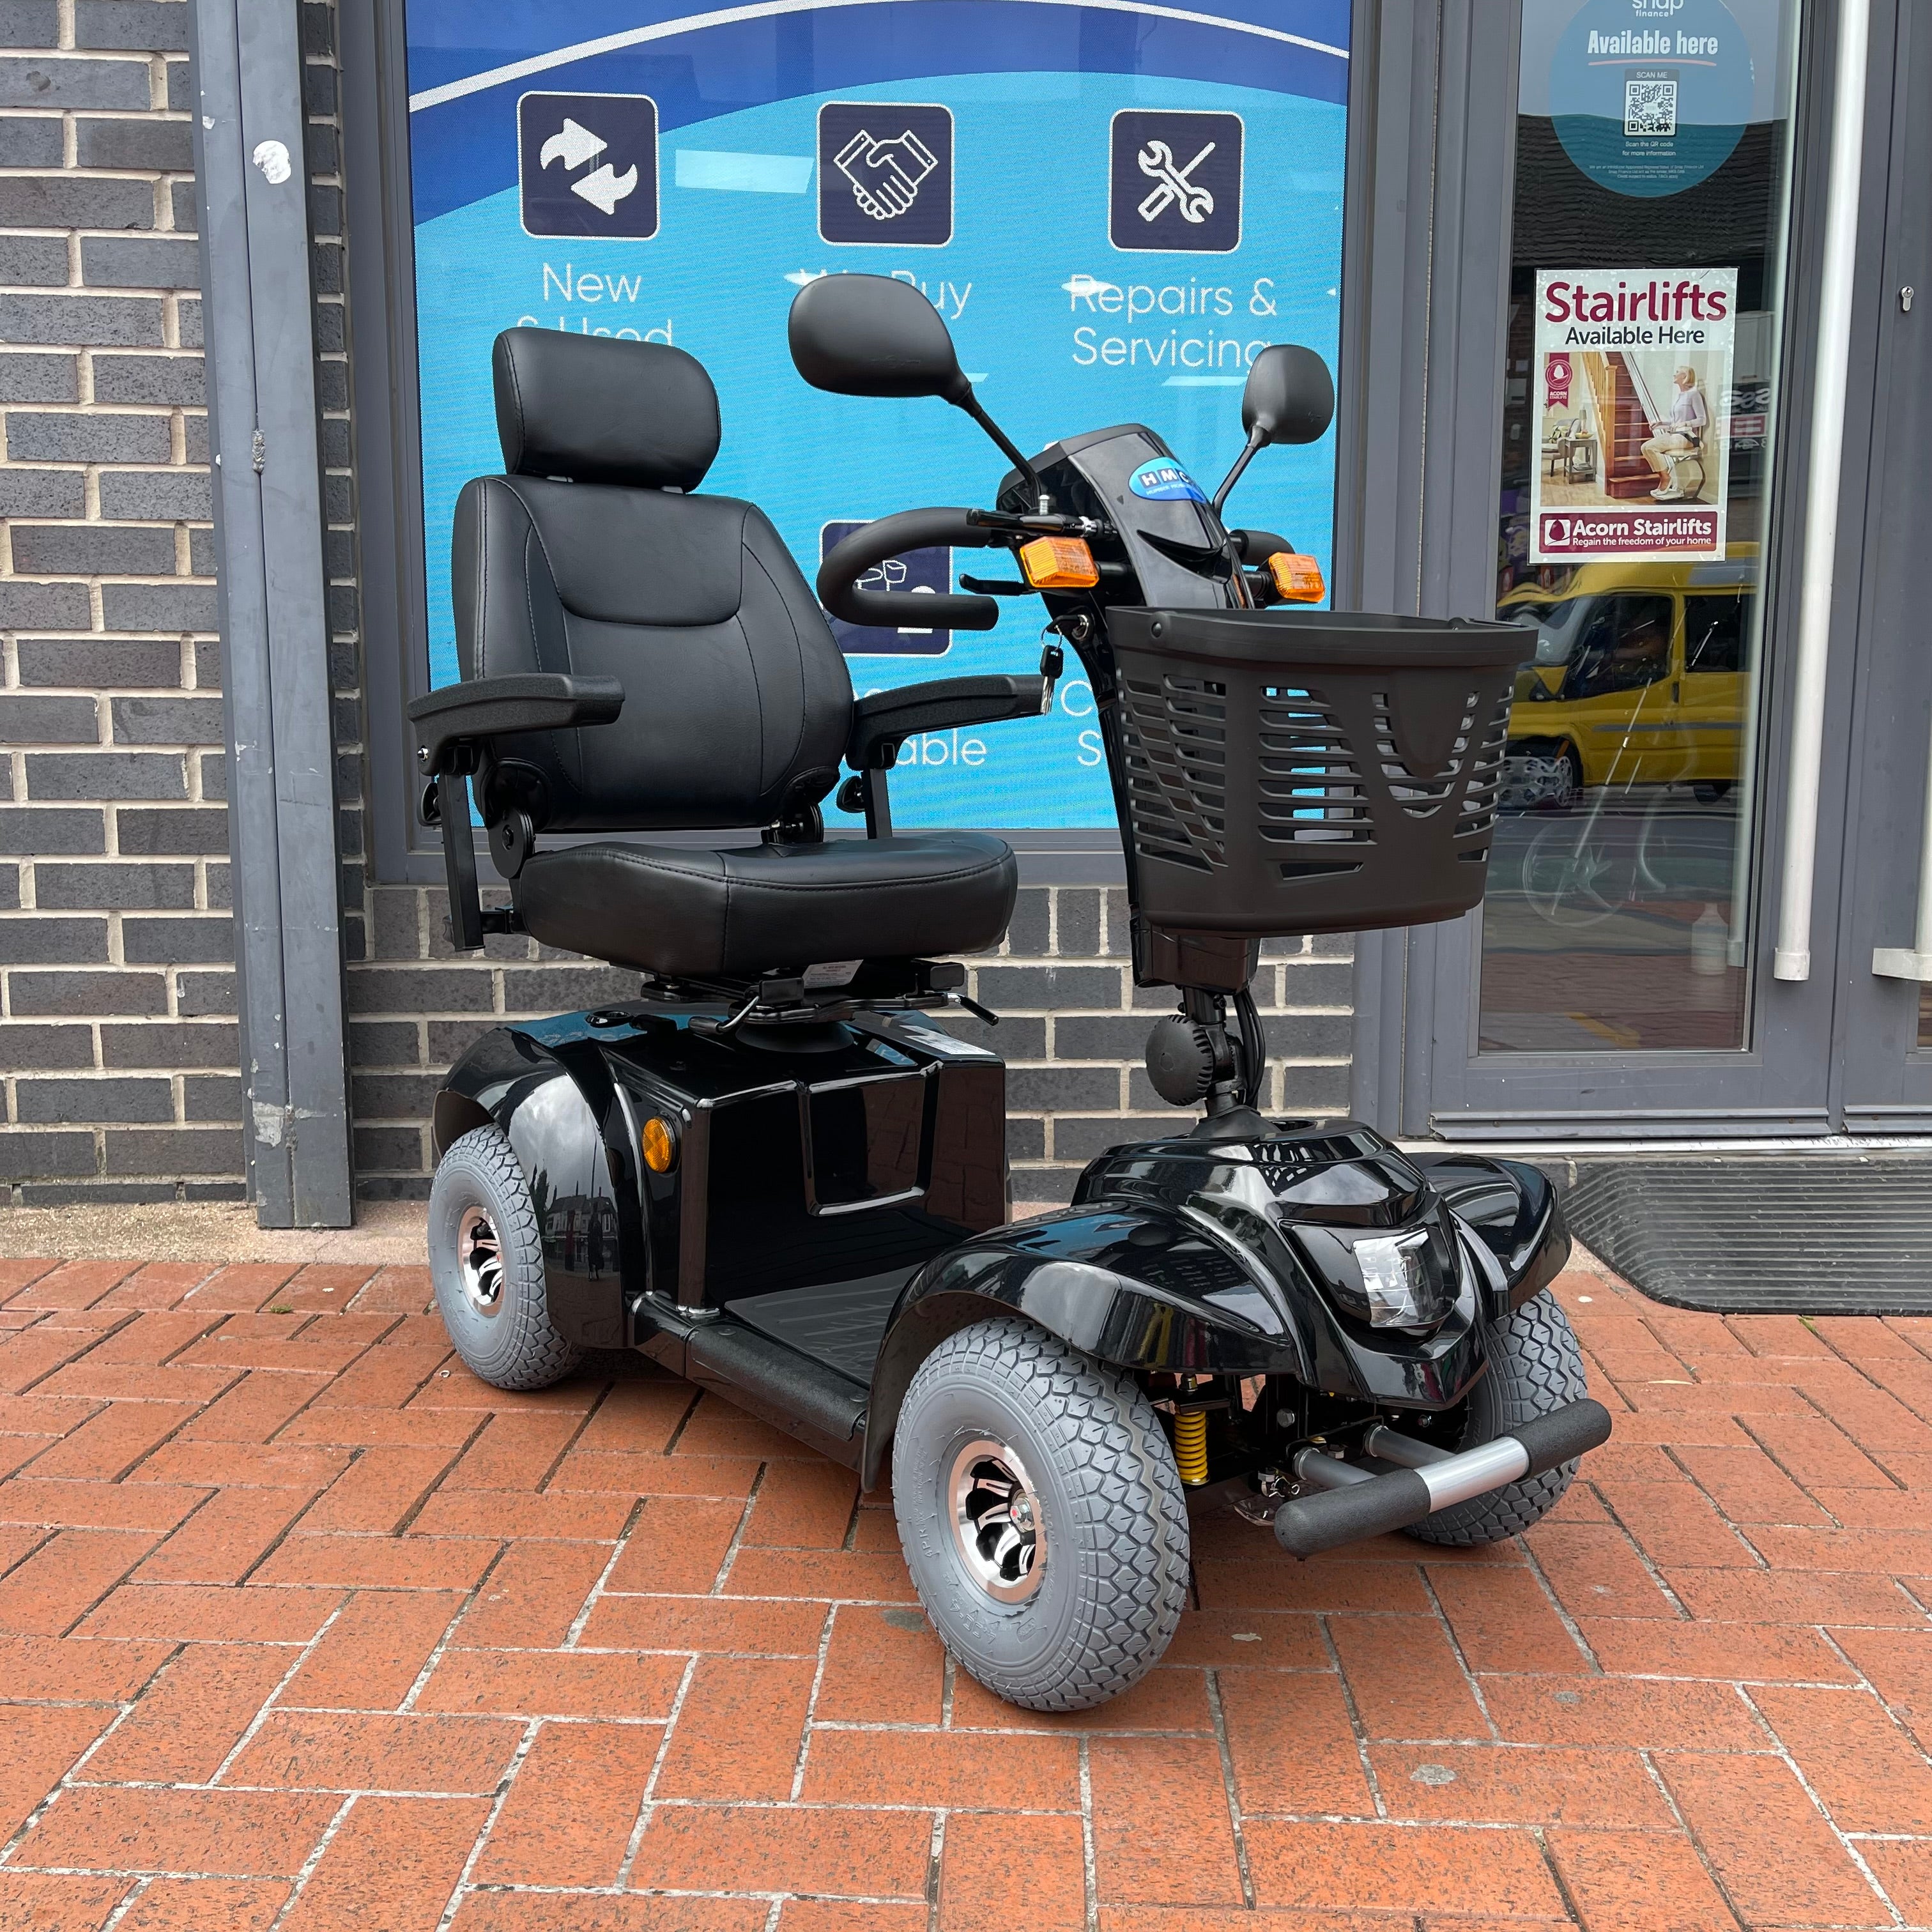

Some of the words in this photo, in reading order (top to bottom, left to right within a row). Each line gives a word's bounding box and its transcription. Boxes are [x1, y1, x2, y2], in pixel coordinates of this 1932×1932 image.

[1636, 9, 1669, 17] finance
[1588, 30, 1671, 54] Available
[1676, 31, 1718, 54] here
[542, 263, 641, 303] New
[1070, 274, 1234, 323] Repairs
[1249, 277, 1277, 316] &
[1545, 281, 1727, 323] Stairlifts
[1565, 326, 1653, 345] Available
[1659, 326, 1705, 344] Here
[1572, 519, 1629, 536] Acorn
[1633, 518, 1712, 535] Stairlifts
[1572, 537, 1600, 547] Regain
[1603, 537, 1616, 546] the
[1618, 537, 1653, 545] freedom
[1655, 537, 1665, 545] of
[1666, 538, 1685, 547] your
